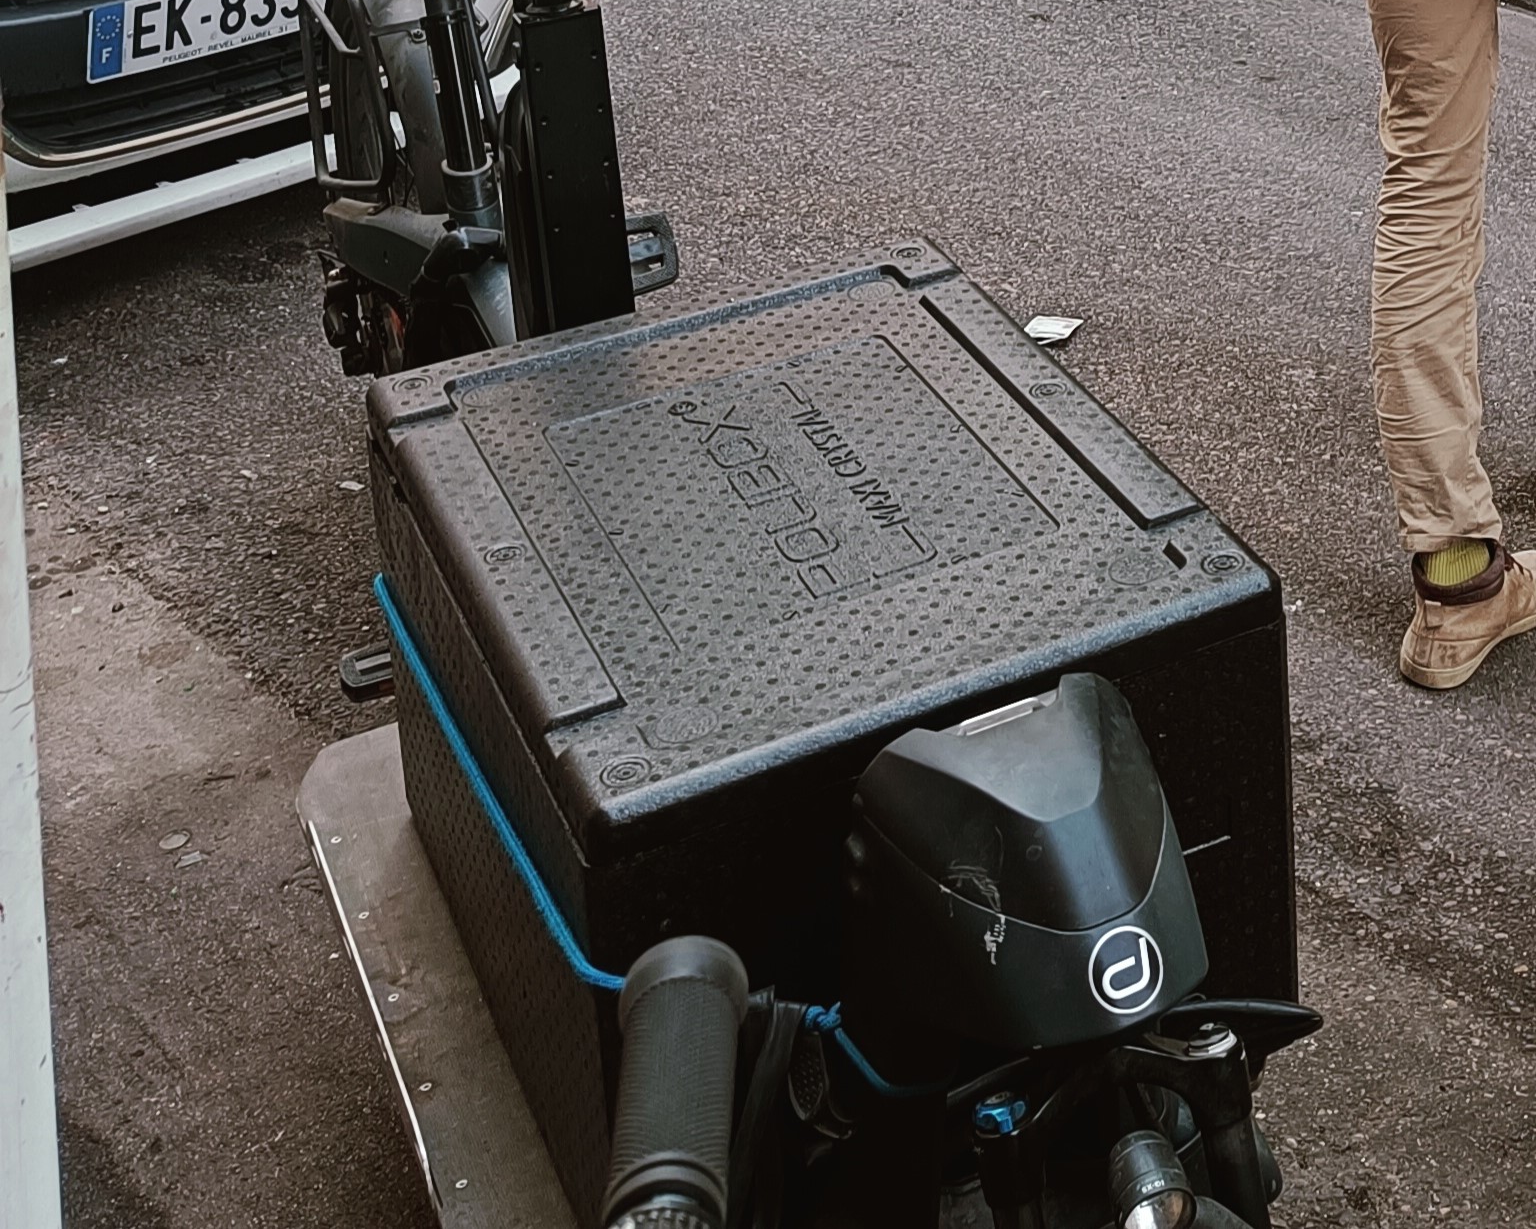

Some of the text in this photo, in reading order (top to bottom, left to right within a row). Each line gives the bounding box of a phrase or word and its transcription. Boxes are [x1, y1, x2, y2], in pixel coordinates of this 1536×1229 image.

[101, 47, 113, 64] F
[162, 48, 203, 63] PEUGEOT
[208, 40, 234, 53] REVEL
[240, 30, 272, 44] MAUREL
[790, 407, 911, 529] MAXI CRYSTAL
